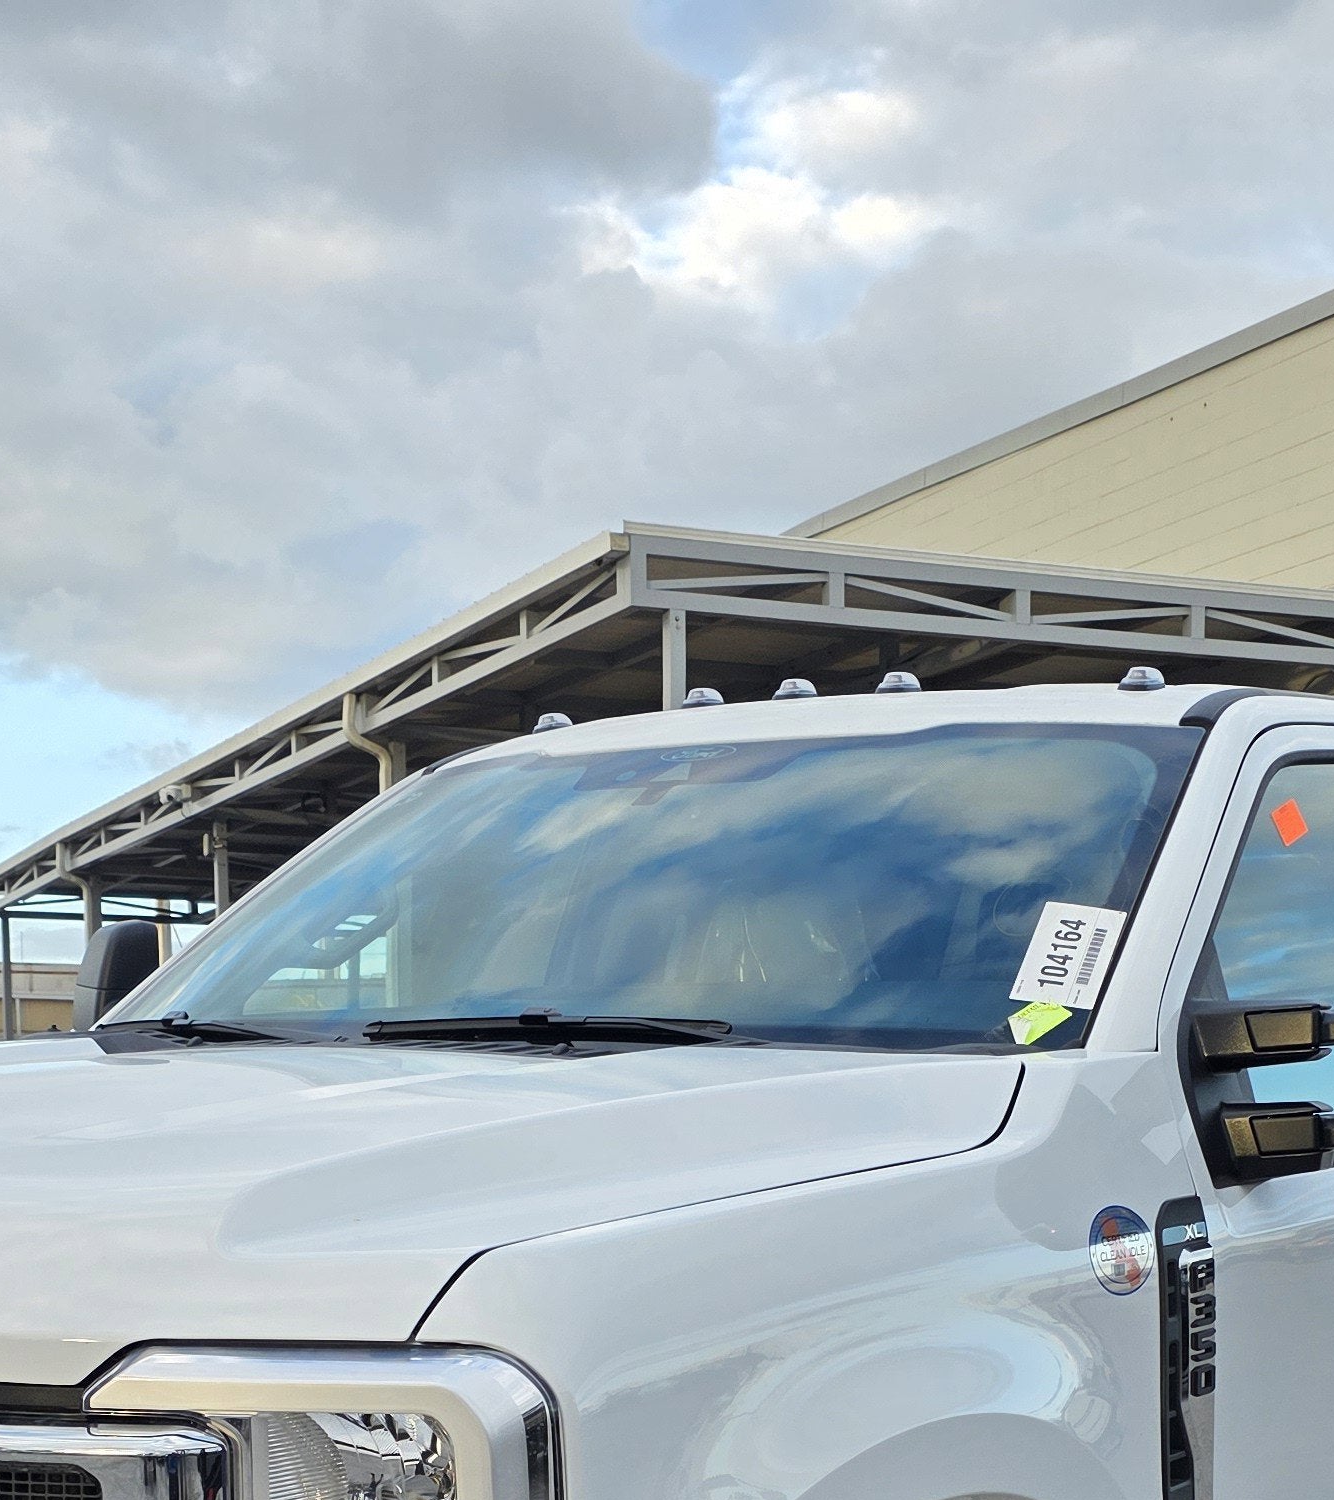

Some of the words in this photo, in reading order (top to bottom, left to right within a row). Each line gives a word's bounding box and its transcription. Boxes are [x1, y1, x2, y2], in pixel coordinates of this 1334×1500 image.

[1037, 919, 1087, 988] 104164
[1184, 1223, 1206, 1241] XL
[1189, 1257, 1217, 1398] F350
